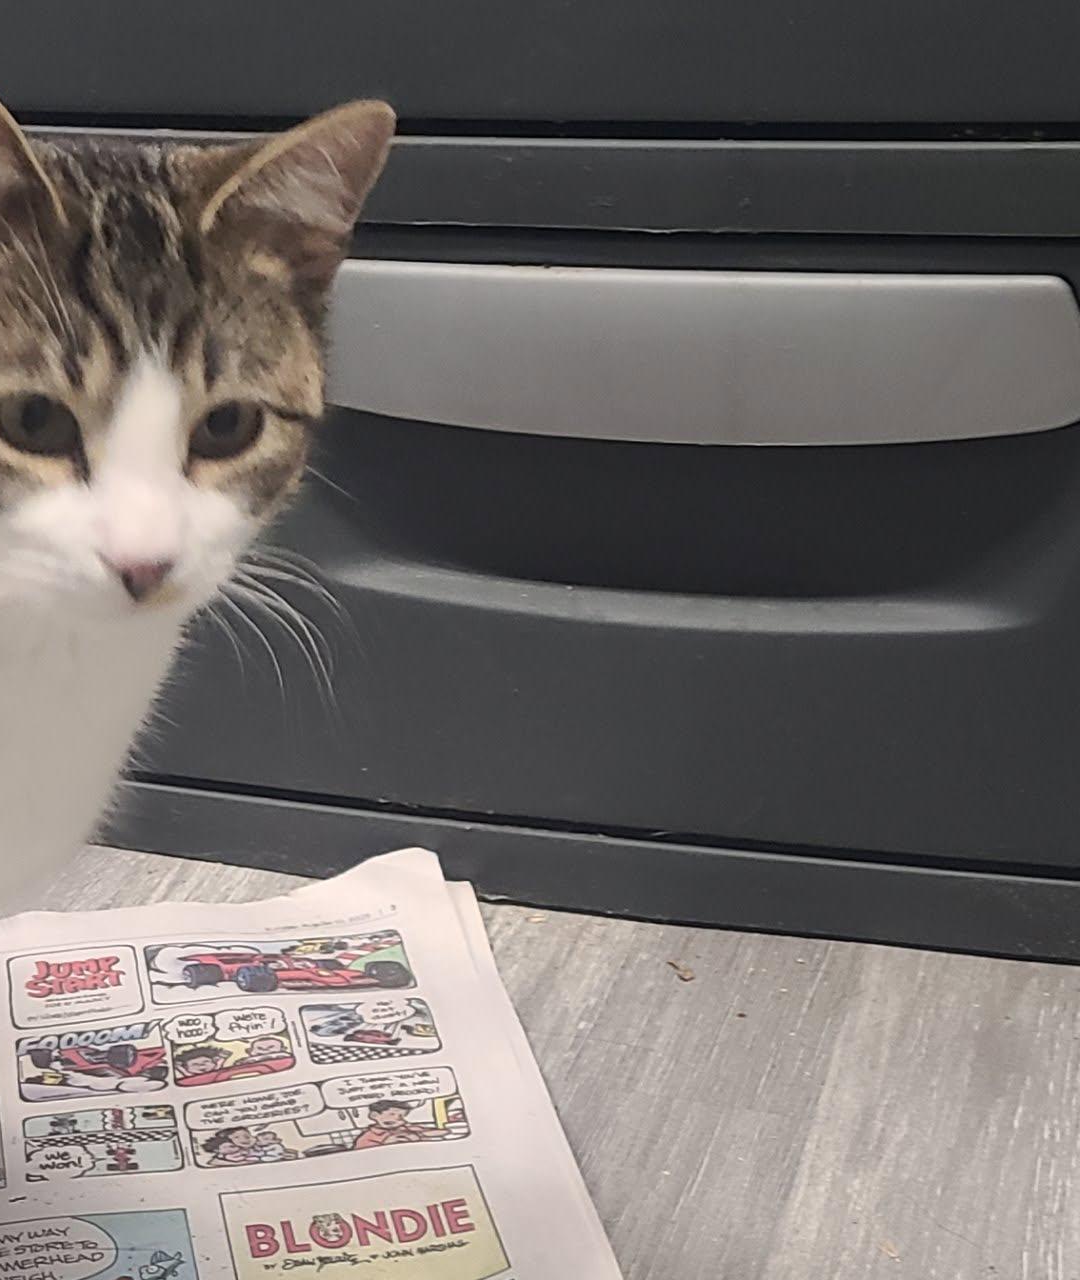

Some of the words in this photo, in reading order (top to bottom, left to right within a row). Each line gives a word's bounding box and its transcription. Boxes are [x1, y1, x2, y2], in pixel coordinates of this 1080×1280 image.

[32, 956, 120, 980] JUMP
[25, 970, 126, 998] START
[39, 1156, 82, 1170] won!
[28, 1226, 70, 1240] WAY
[245, 1198, 476, 1258] BLONDIE
[14, 1240, 74, 1255] STORE
[75, 1240, 99, 1250] TO
